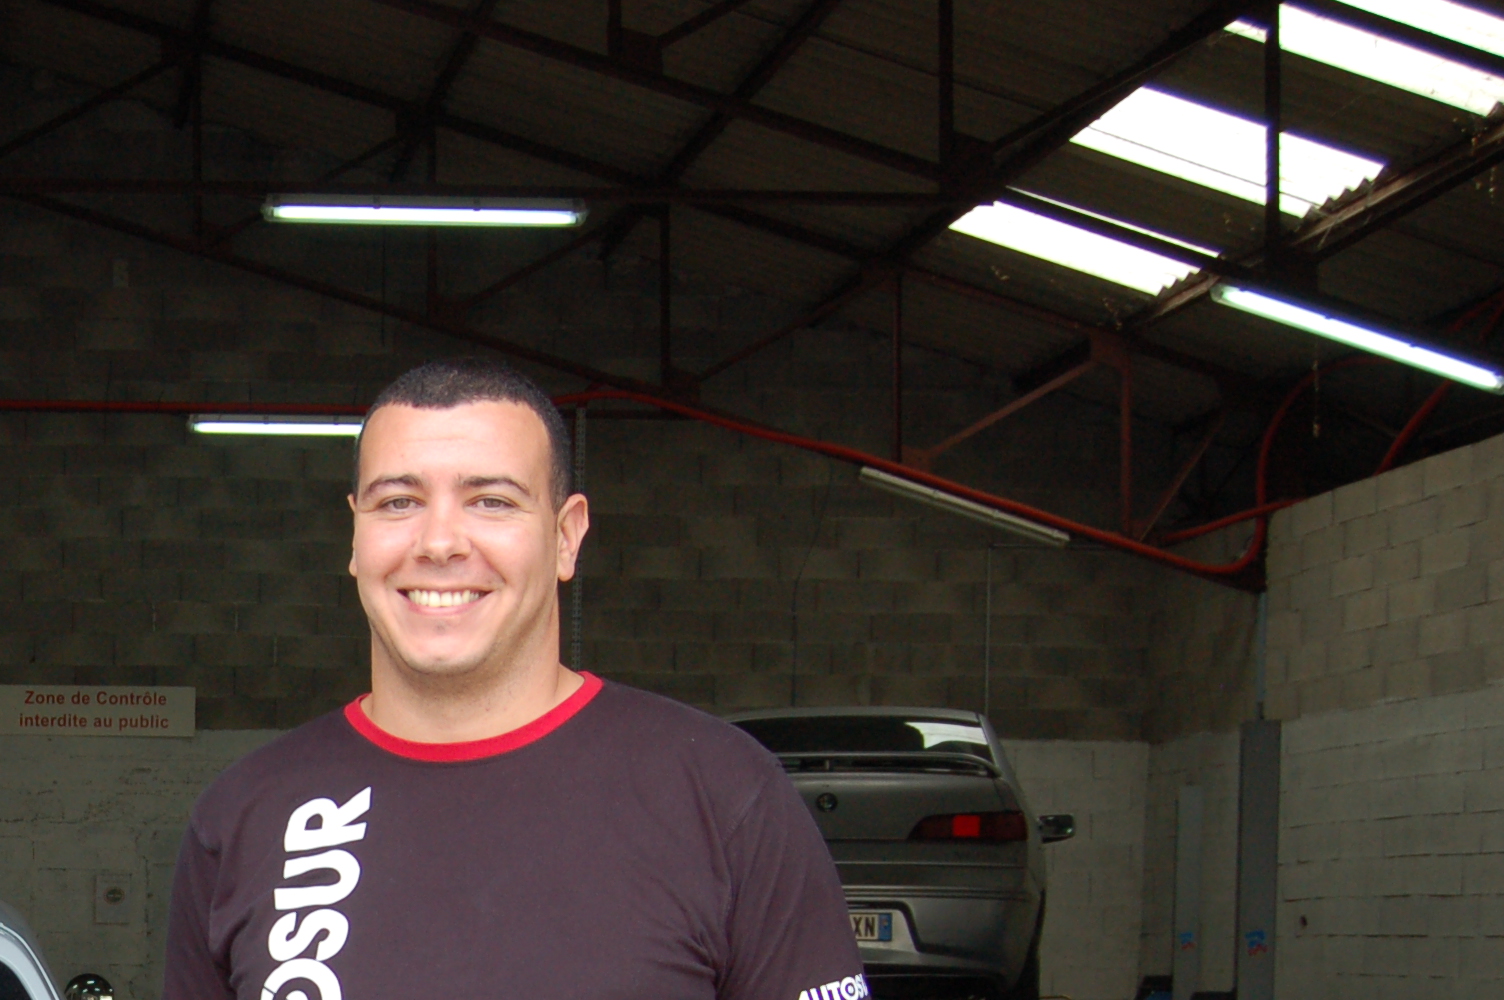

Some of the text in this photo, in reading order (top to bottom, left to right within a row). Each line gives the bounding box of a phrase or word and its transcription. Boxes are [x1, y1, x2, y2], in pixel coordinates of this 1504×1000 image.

[24, 690, 167, 706] Zone de Contrôle
[19, 713, 170, 731] interdite au public
